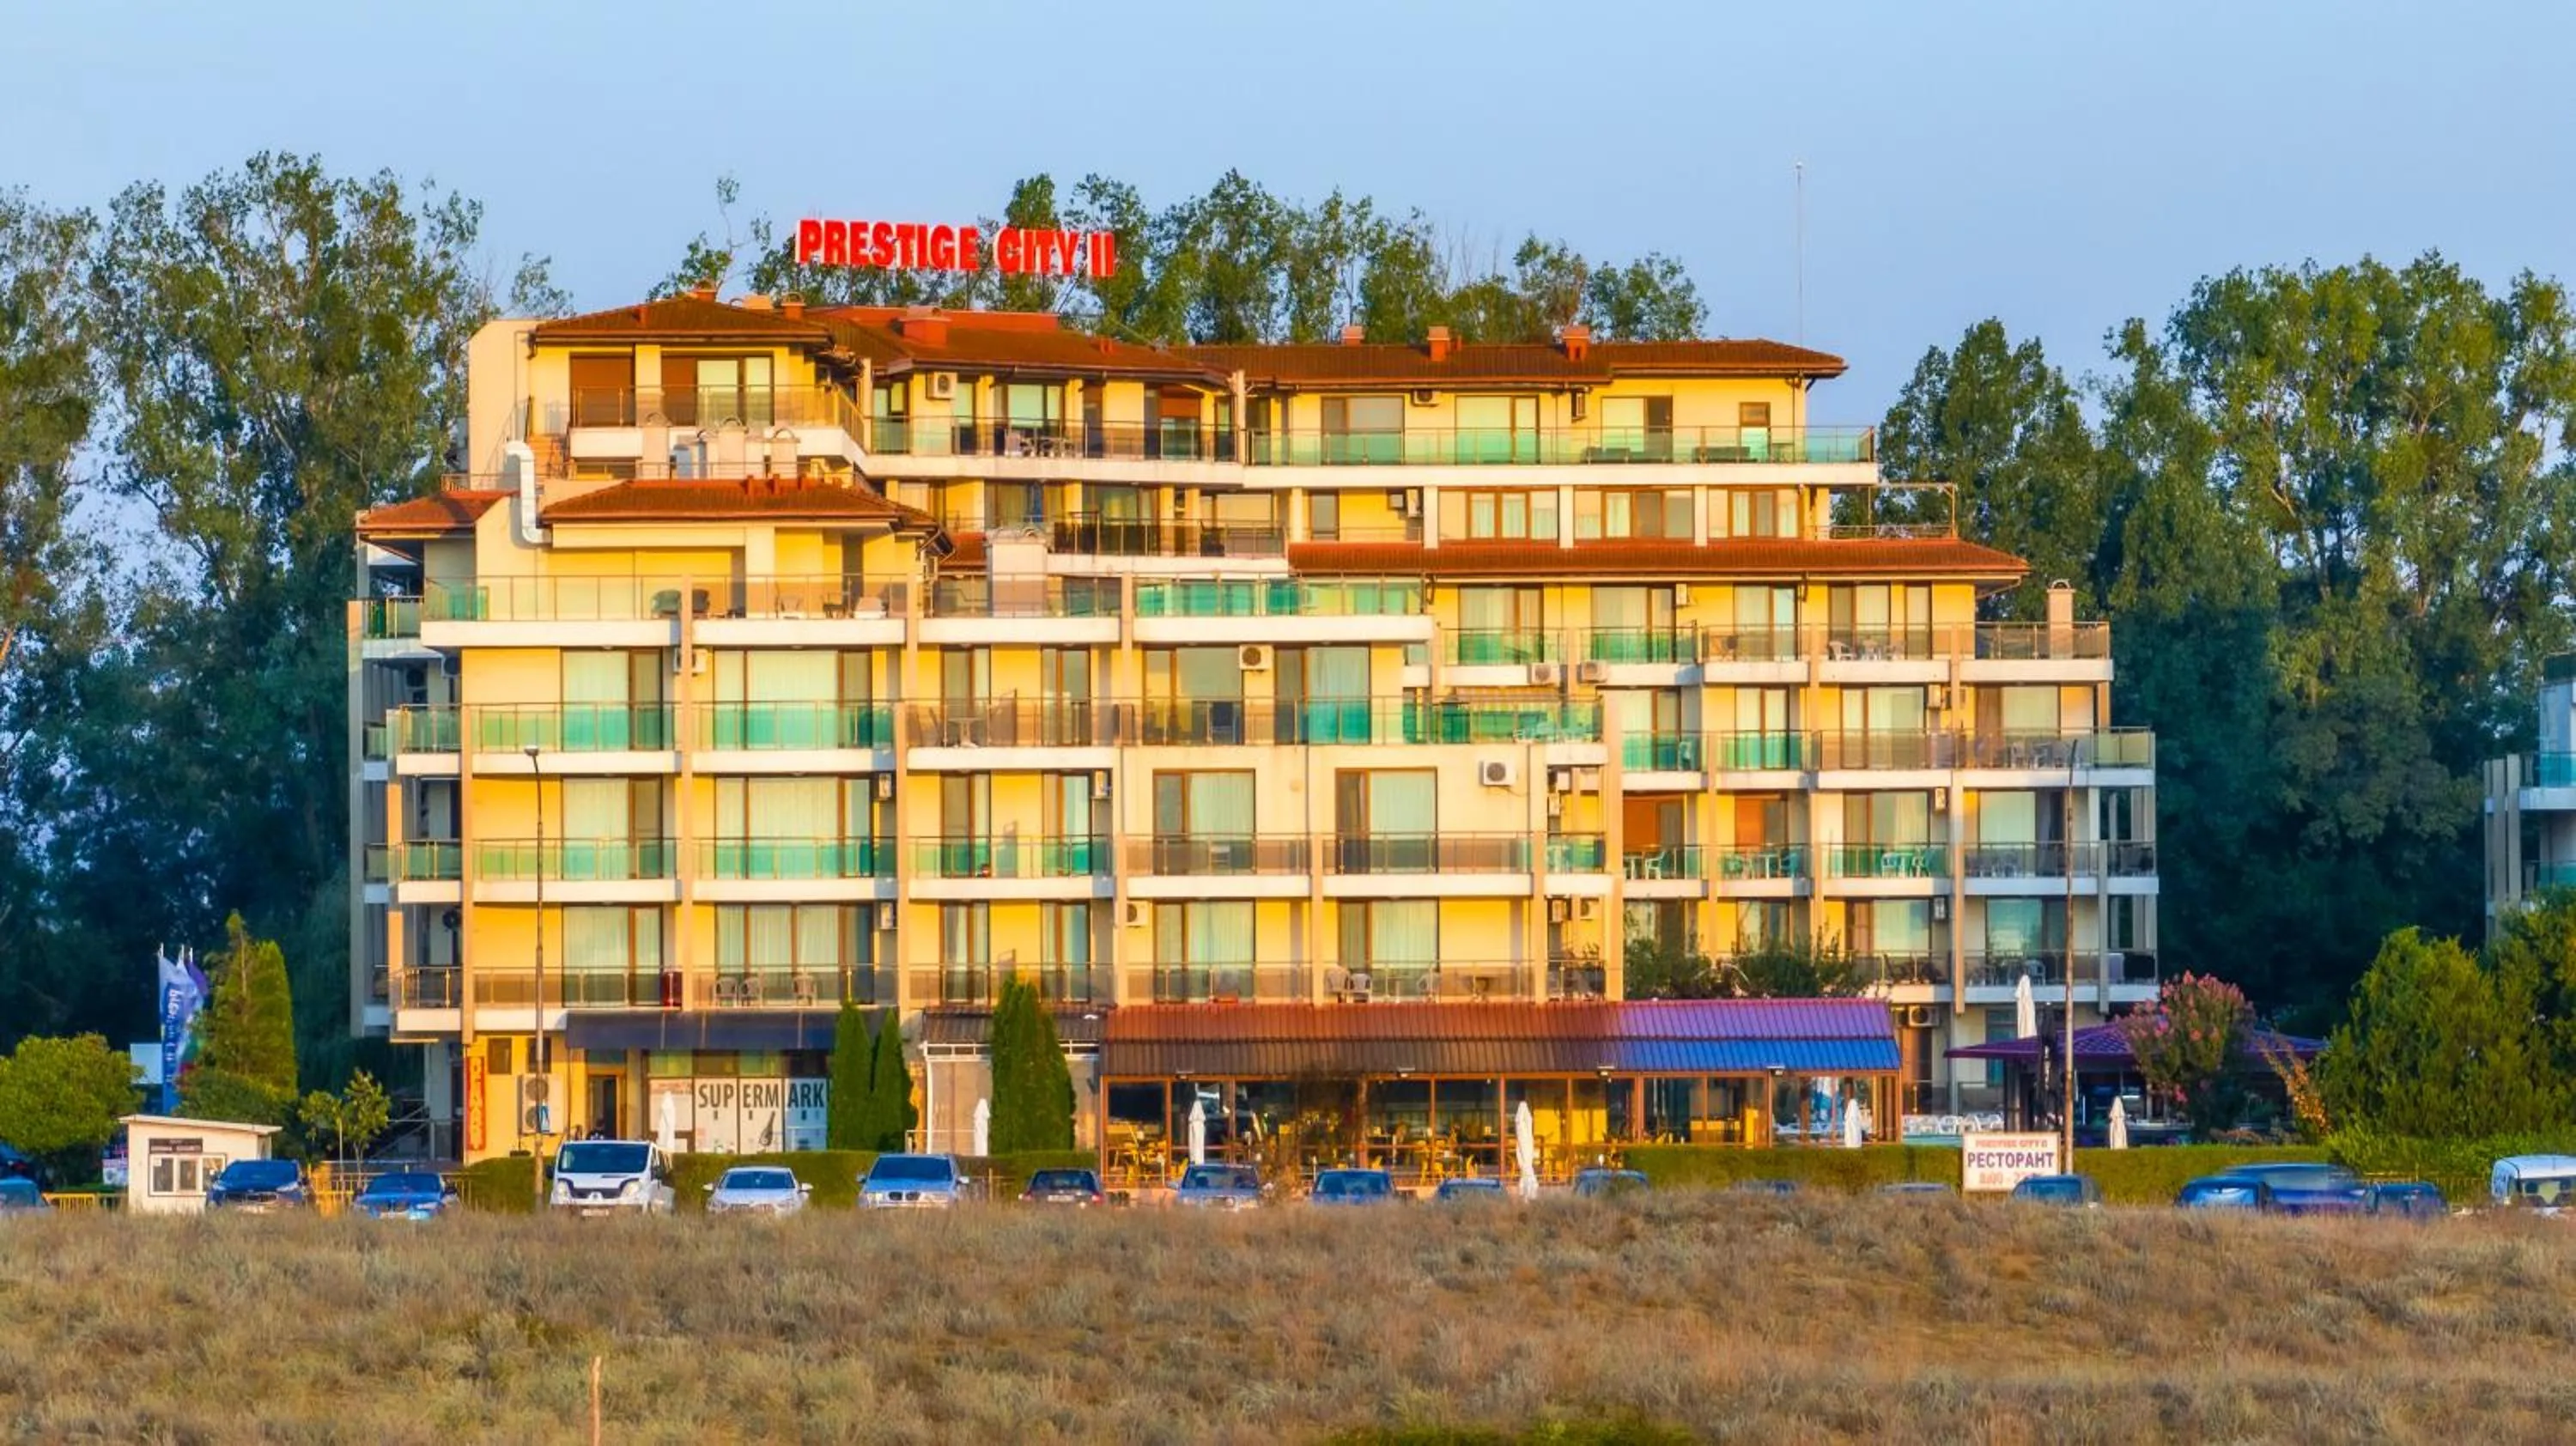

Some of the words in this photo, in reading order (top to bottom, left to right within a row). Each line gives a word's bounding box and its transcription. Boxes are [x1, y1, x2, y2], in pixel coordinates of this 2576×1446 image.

[797, 219, 979, 271] PRESTIGE
[993, 226, 1080, 276] CITY
[1086, 232, 1117, 277] II
[1967, 1152, 2054, 1168] РЕСТОРАНТ
